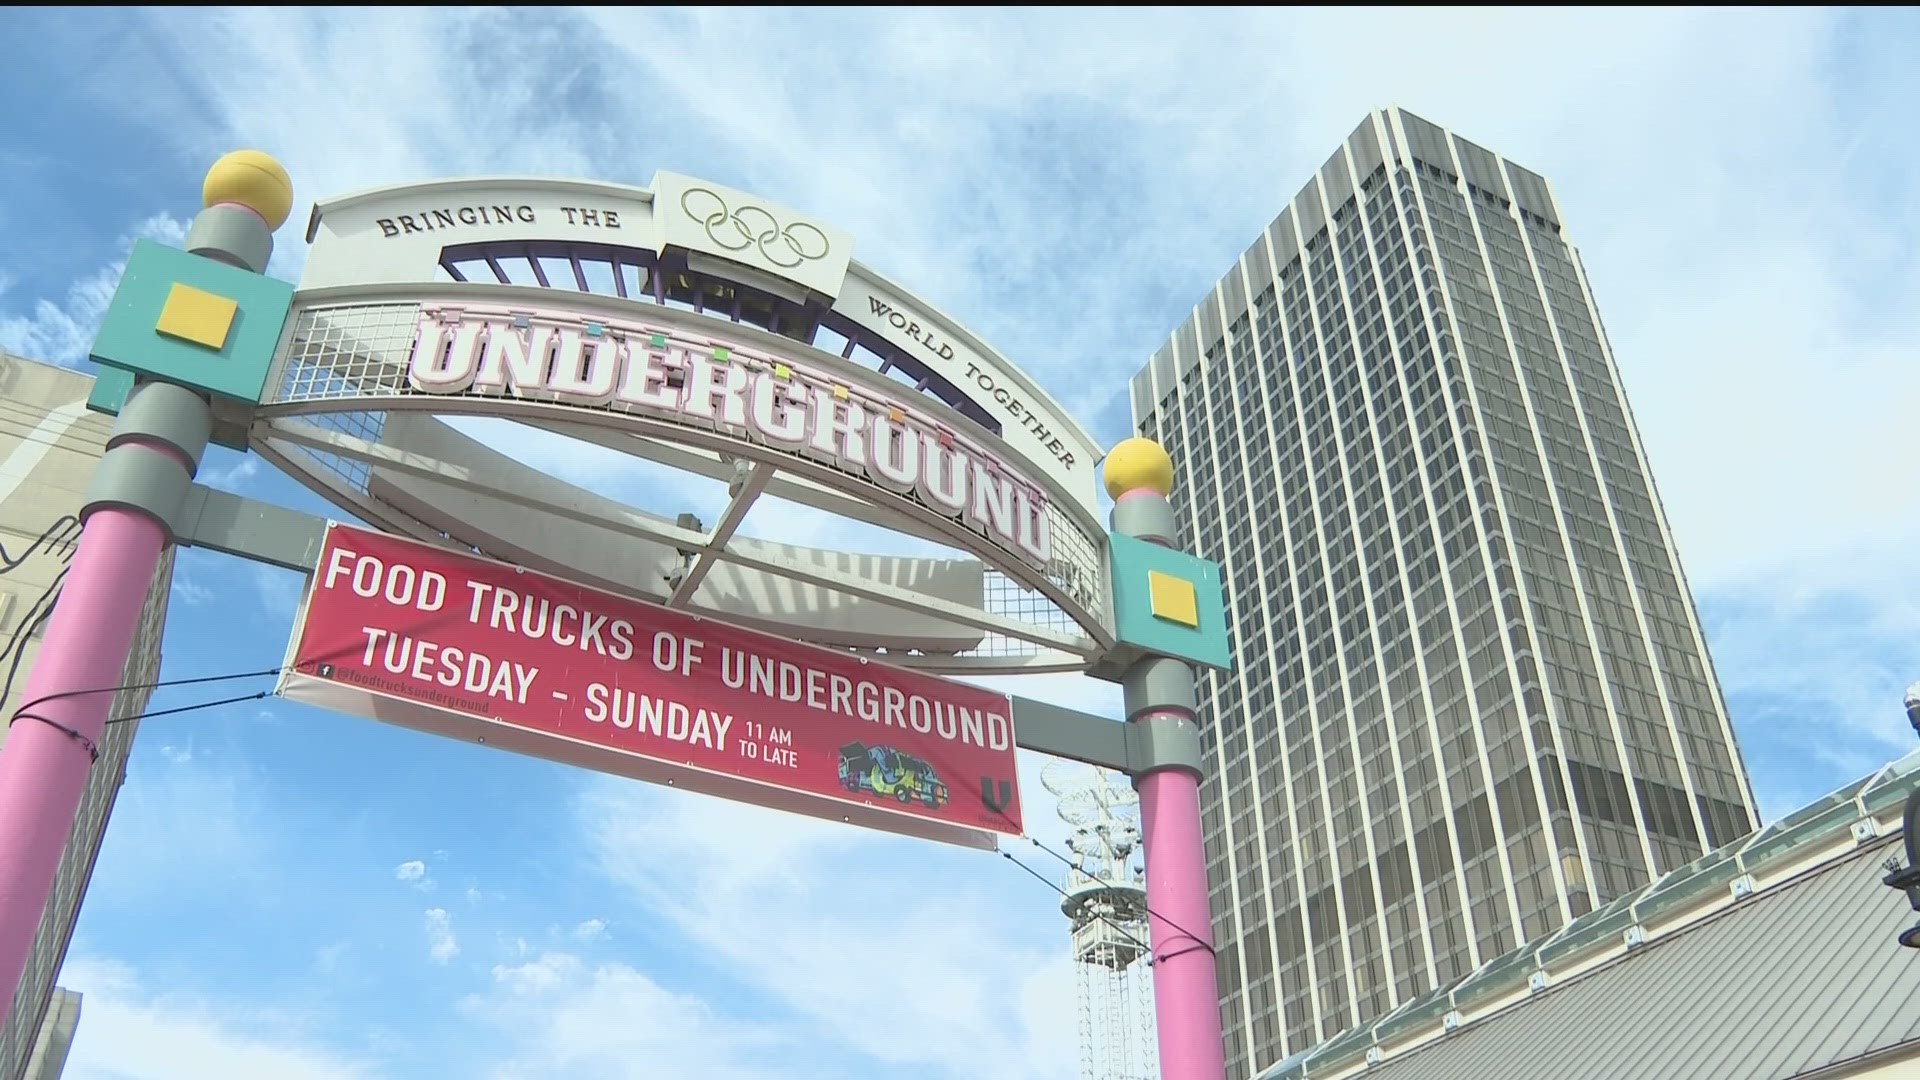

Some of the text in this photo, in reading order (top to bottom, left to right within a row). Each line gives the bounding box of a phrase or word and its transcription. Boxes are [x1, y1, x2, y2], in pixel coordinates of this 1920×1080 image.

[376, 204, 621, 237] BRINGING THE
[408, 316, 1050, 567] UNDERGROUND
[868, 296, 1077, 471] WORLD TOGETHER
[324, 547, 1010, 752] FOOD TRUCKS OF UNDERGROUND
[362, 626, 539, 704] TUESDAY
[584, 682, 733, 752] SUNDAY
[738, 739, 798, 769] TO LATE
[745, 721, 793, 747] 11 AM
